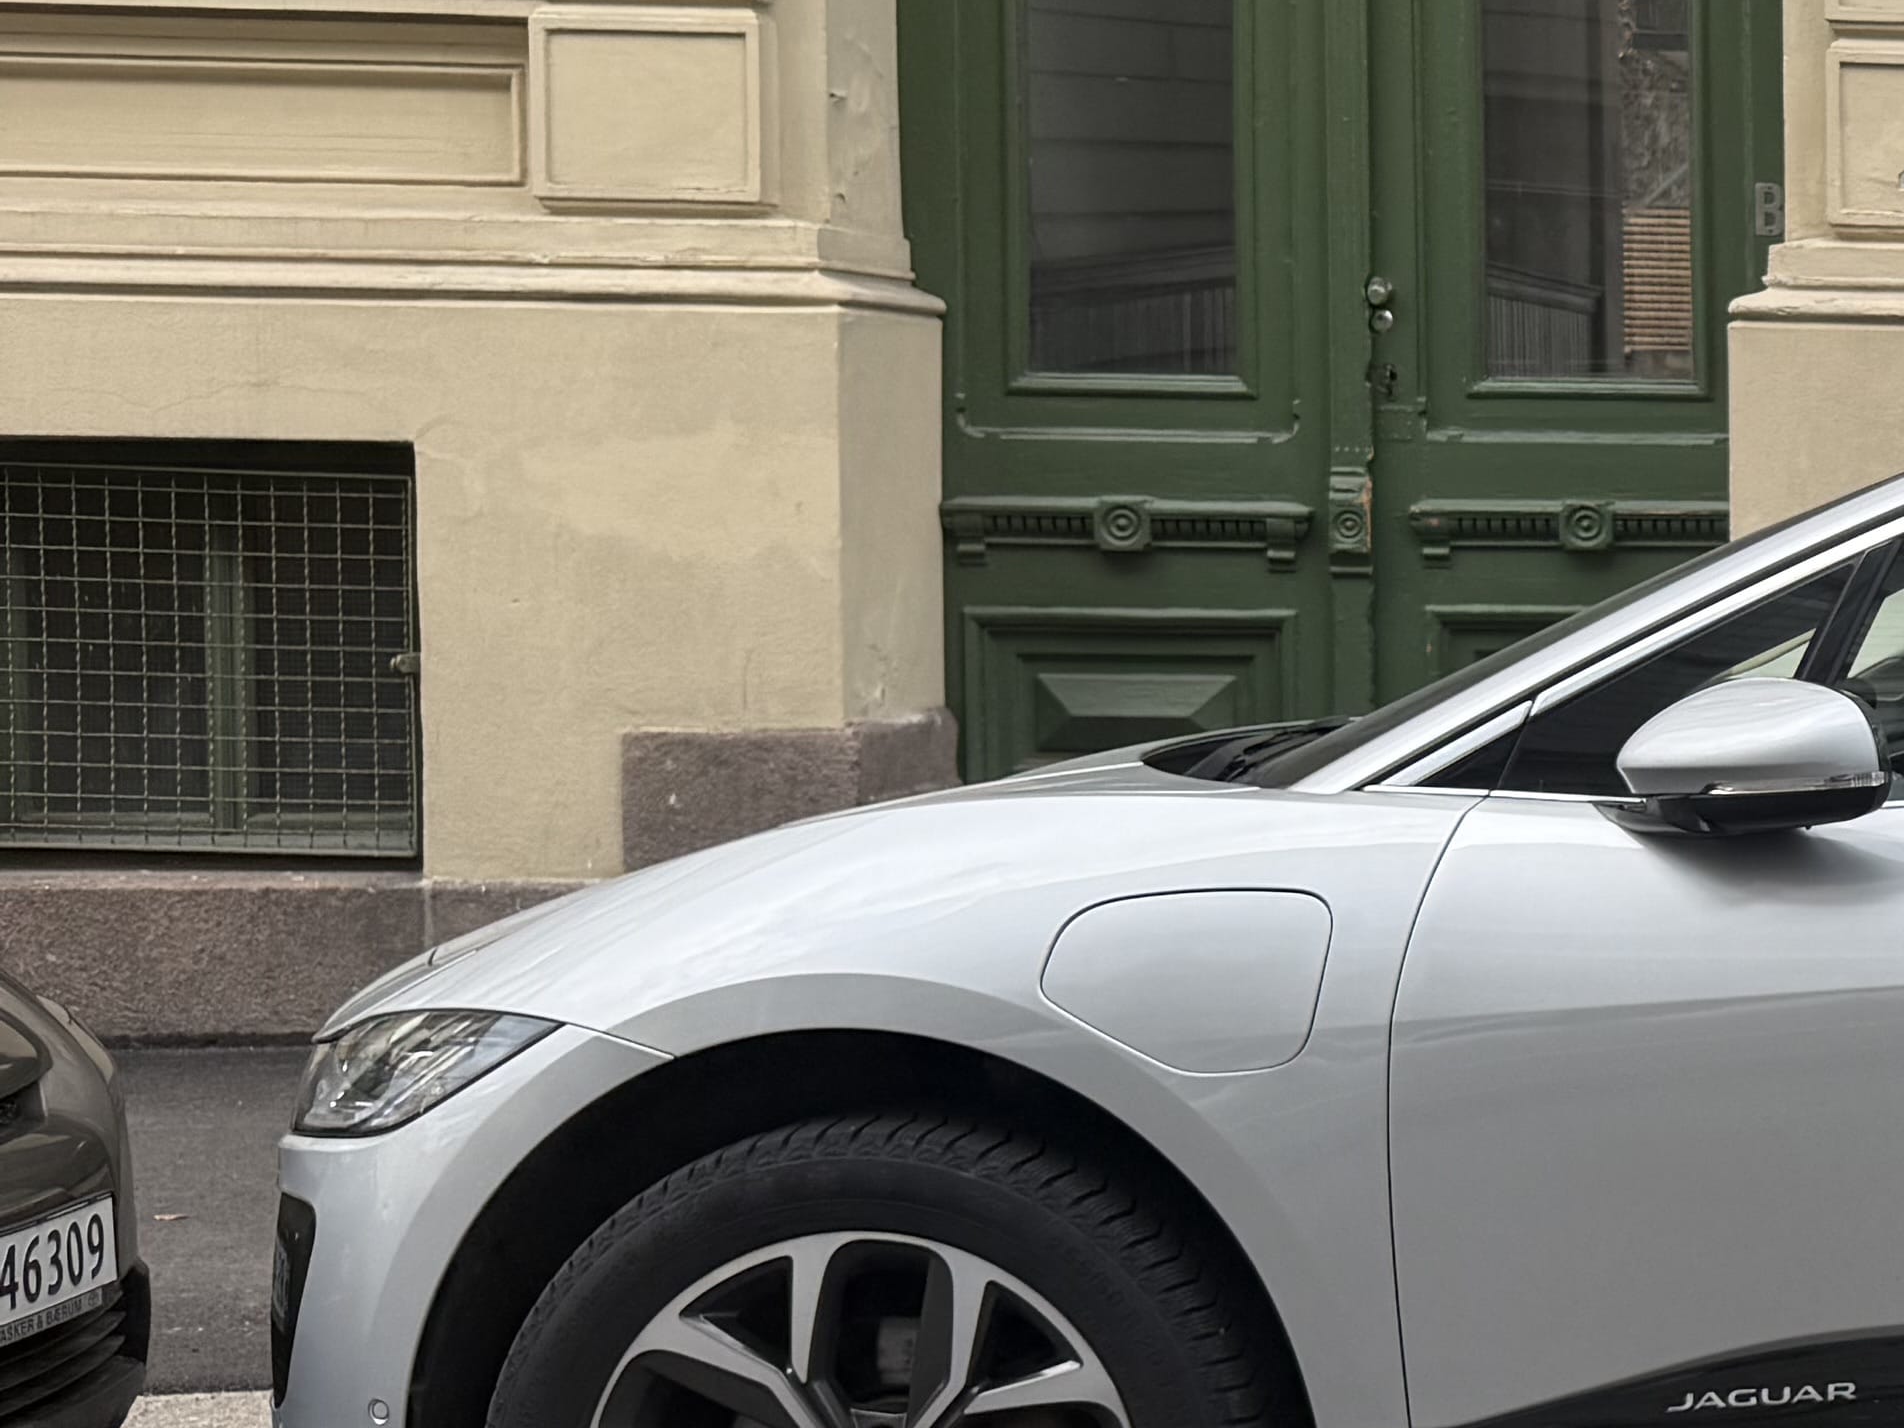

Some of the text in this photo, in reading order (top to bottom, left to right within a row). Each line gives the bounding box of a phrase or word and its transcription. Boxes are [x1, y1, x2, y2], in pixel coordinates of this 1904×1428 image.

[1755, 182, 1785, 236] B
[0, 1213, 104, 1310] 46309
[1664, 1381, 1857, 1414] JAGUAR
